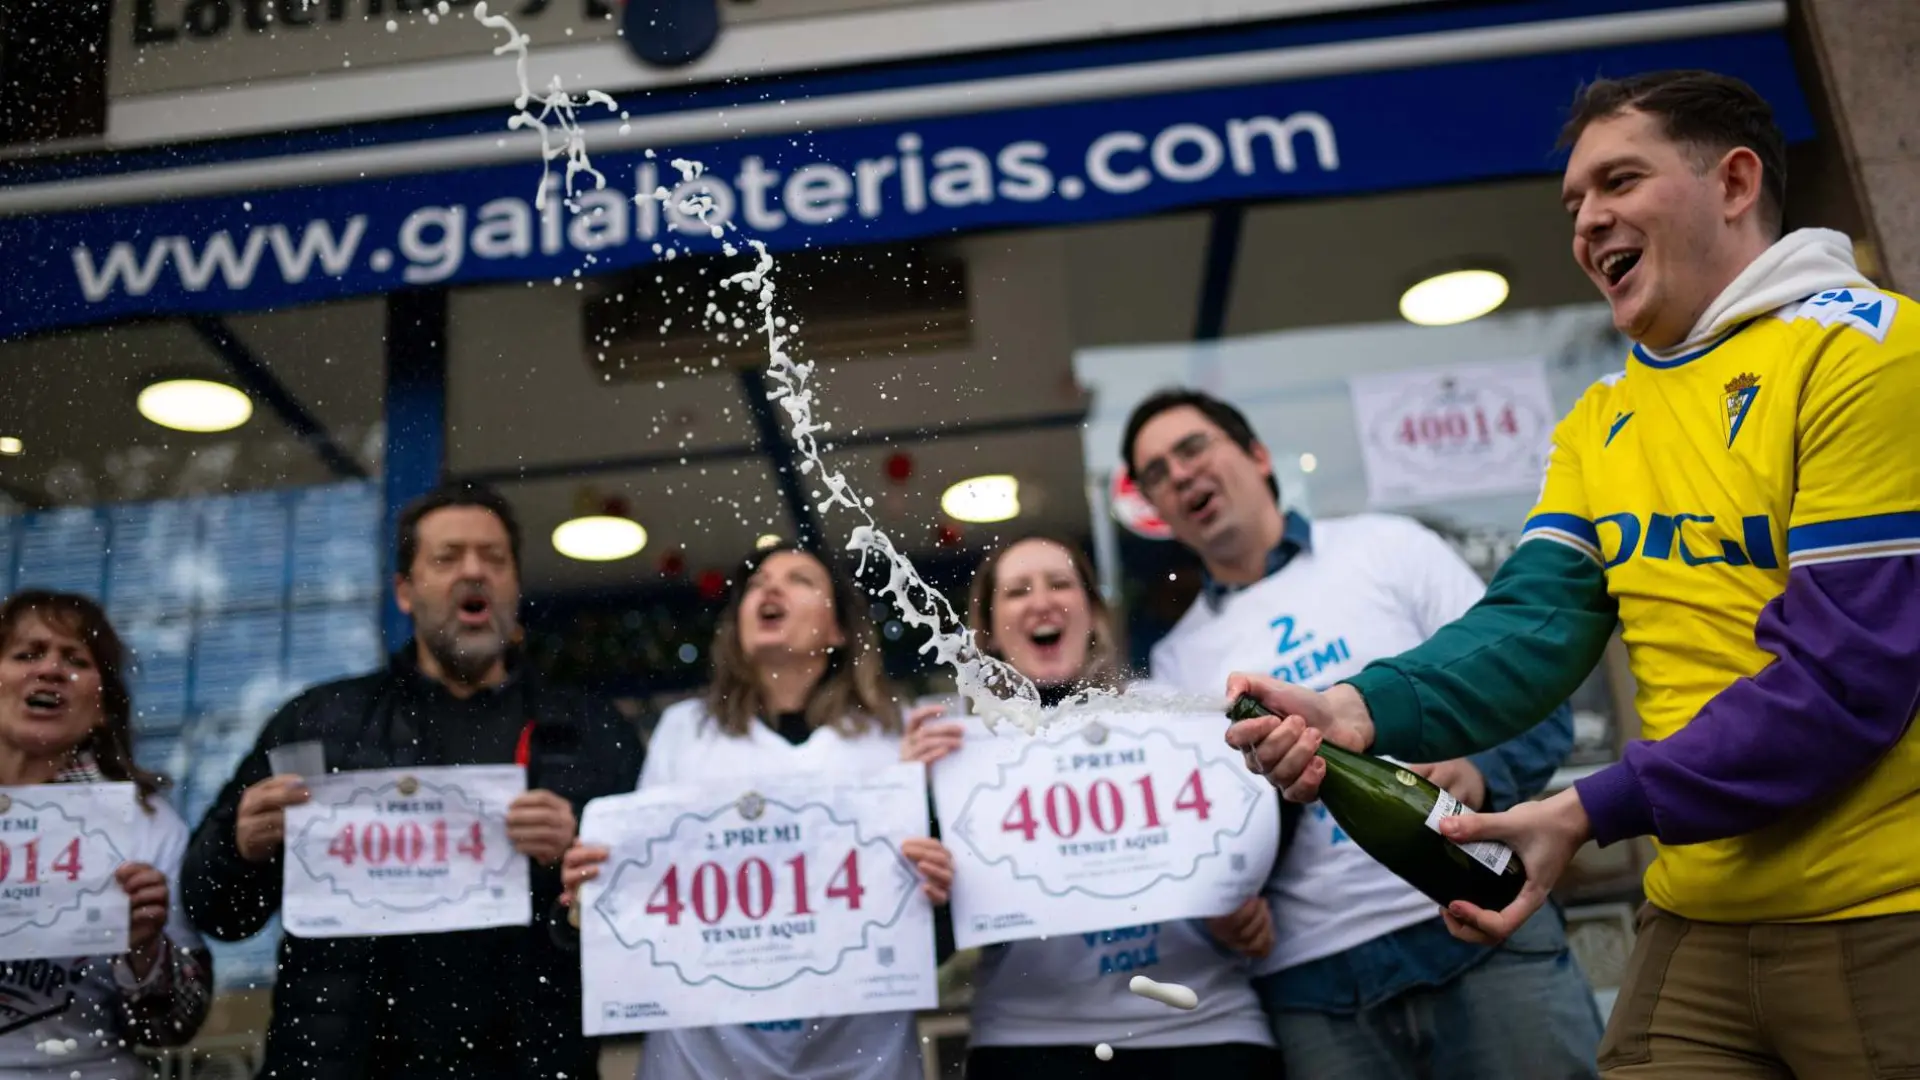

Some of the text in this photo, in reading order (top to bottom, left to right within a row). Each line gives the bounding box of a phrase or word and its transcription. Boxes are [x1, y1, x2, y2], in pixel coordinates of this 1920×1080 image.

[72, 109, 1341, 302] www.gaialoterias.com
[1397, 402, 1520, 447] 40014
[723, 824, 801, 847] PREMI
[1001, 768, 1213, 842] 40014
[327, 818, 486, 866] 40014
[645, 848, 866, 926] 40014
